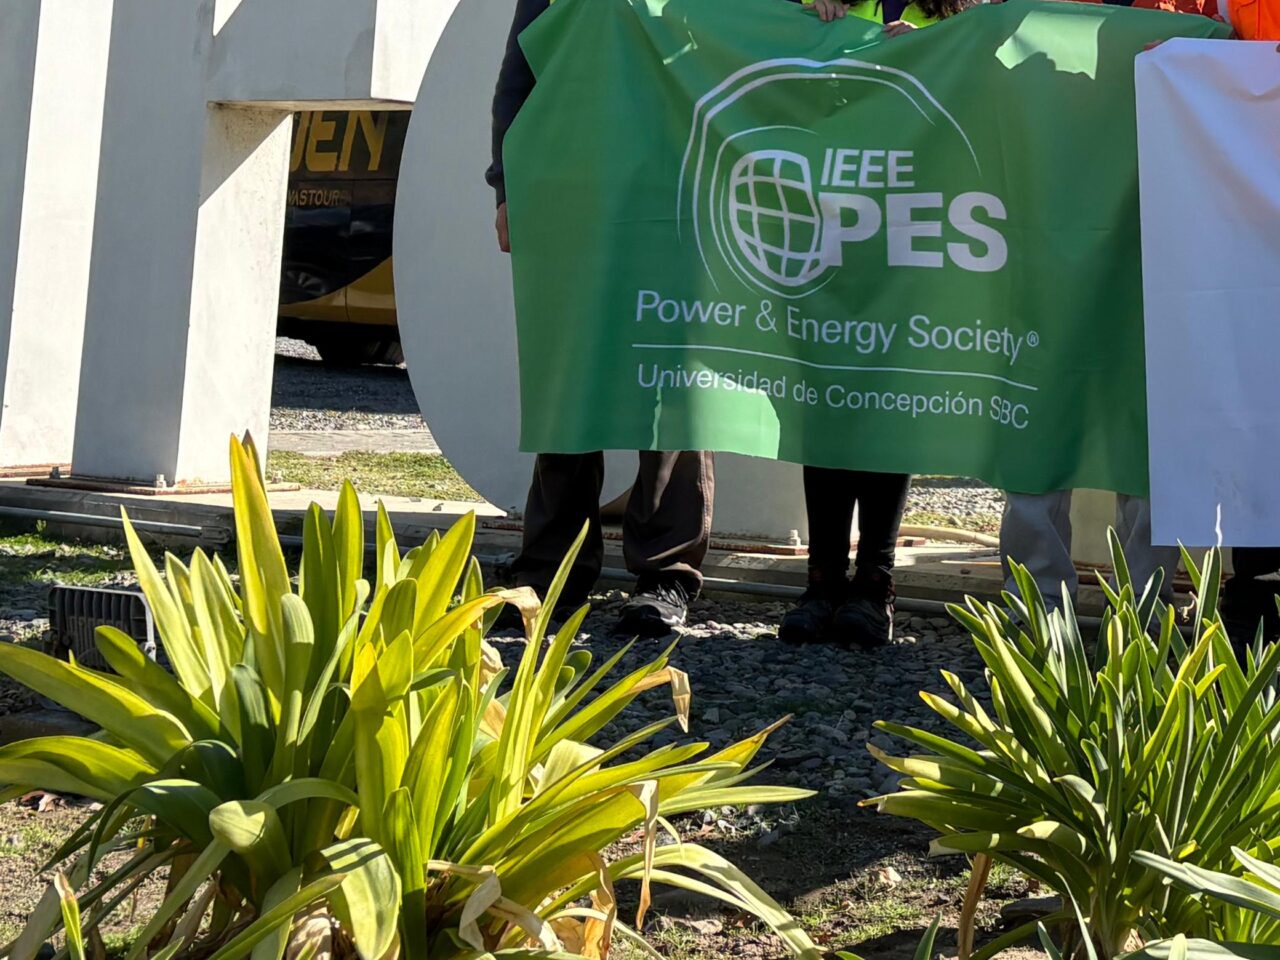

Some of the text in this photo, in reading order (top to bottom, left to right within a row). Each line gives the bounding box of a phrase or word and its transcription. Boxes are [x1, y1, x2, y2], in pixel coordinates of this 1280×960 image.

[820, 147, 916, 188] IEEE
[818, 191, 1009, 272] PES
[636, 289, 747, 328] Power
[755, 299, 779, 334] &
[787, 304, 897, 354] Energy
[638, 363, 1030, 430] Universidad de Concepción SBC
